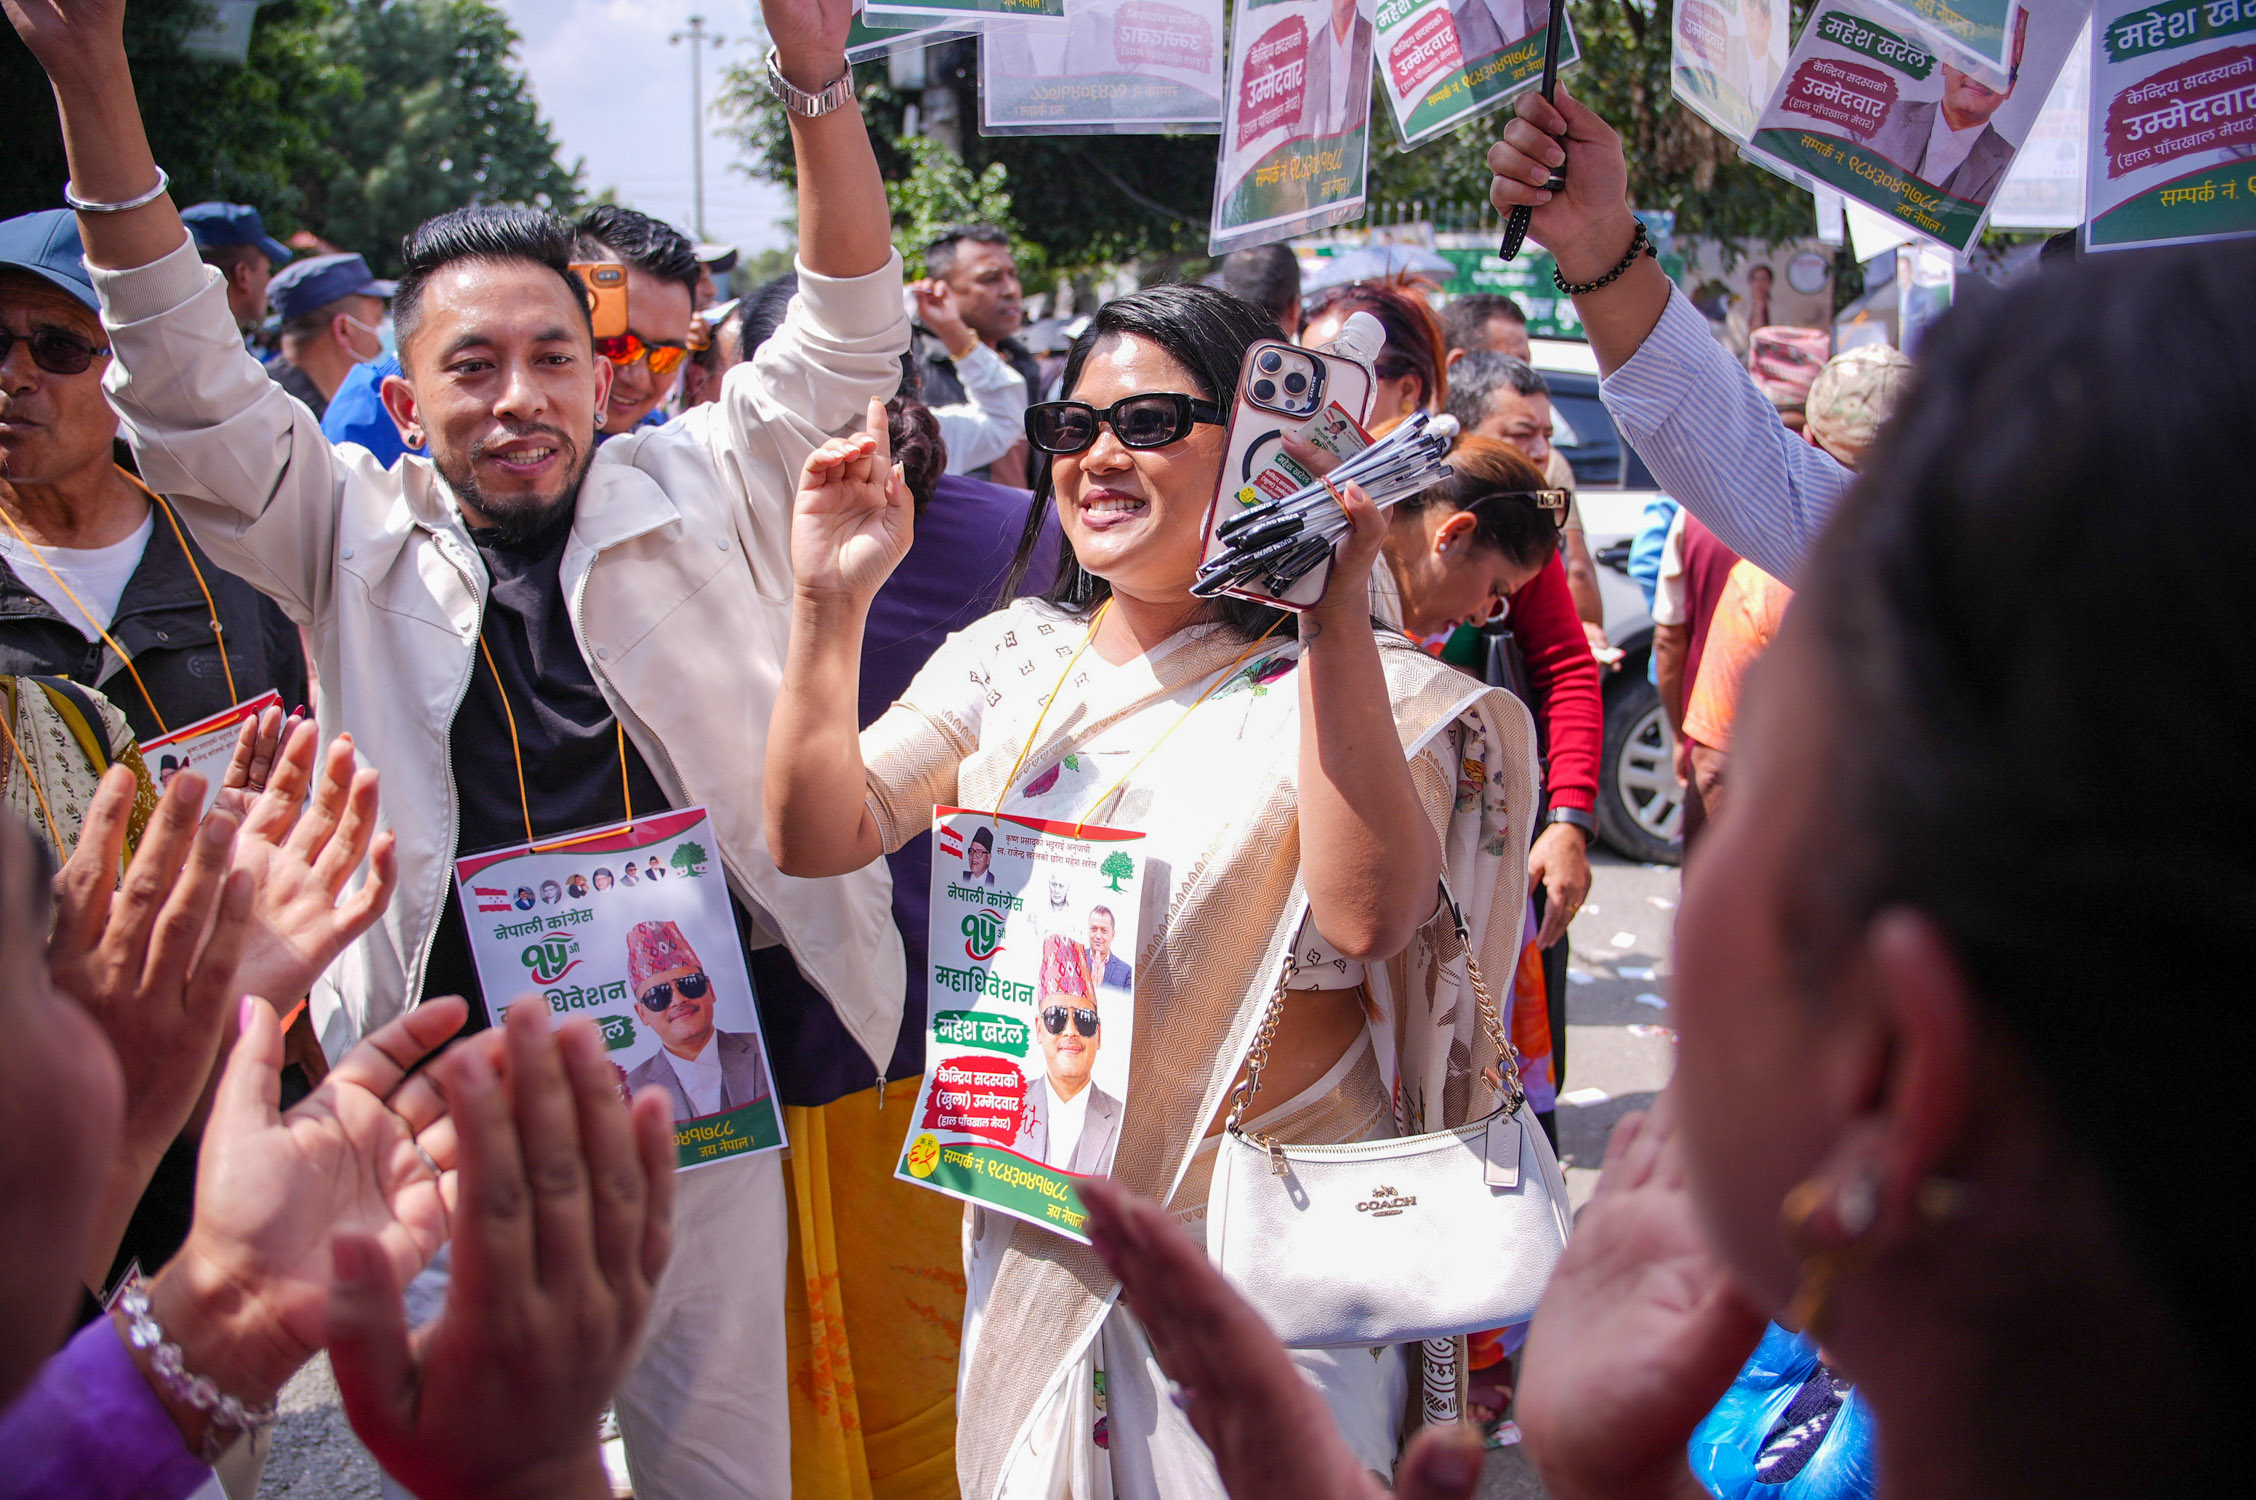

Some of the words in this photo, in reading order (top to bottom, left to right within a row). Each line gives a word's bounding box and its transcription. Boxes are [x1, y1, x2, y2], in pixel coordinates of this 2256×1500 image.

[1825, 17, 1874, 51] महेश
[1876, 34, 1928, 68] खरेल
[2115, 8, 2198, 50] महेश
[1396, 27, 1454, 76] उम्मेदवार
[1247, 59, 1304, 110] उम्मेदवार
[1813, 60, 1845, 80] केन्द्रिय
[1847, 70, 1888, 94] सदस्यको
[2125, 83, 2180, 106] केन्द्रिय
[2183, 57, 2254, 90] सदस्यको
[1802, 76, 1886, 118] उम्मेदवार
[2117, 149, 2151, 169] (हाल
[2154, 130, 2215, 156] पाँचखाल
[1801, 134, 1835, 159] सम्पर्क
[1849, 152, 1941, 213] ९८४३०४१७८८
[2160, 180, 2217, 207] सम्पर्क
[947, 882, 984, 905] नेपाली
[986, 890, 1024, 912] कांग्रेस
[493, 917, 544, 942] नेपाली
[546, 907, 594, 931] कांग्रेस
[935, 964, 1035, 1006] महाधिवेशन
[938, 1013, 977, 1042] महेश
[981, 1018, 1024, 1044] खरेल
[938, 1066, 972, 1086] केन्द्रिय
[974, 1069, 1019, 1089] सदस्यको
[936, 1091, 971, 1111] (खुला)
[973, 1091, 1020, 1112] उम्मेदवार
[671, 1120, 736, 1146] ०४१७८८
[698, 1143, 718, 1158] जय
[943, 1148, 974, 1170] सम्पर्क
[988, 1159, 1069, 1202] ९८४३०४१७८८
[1355, 1196, 1417, 1212] COACH
